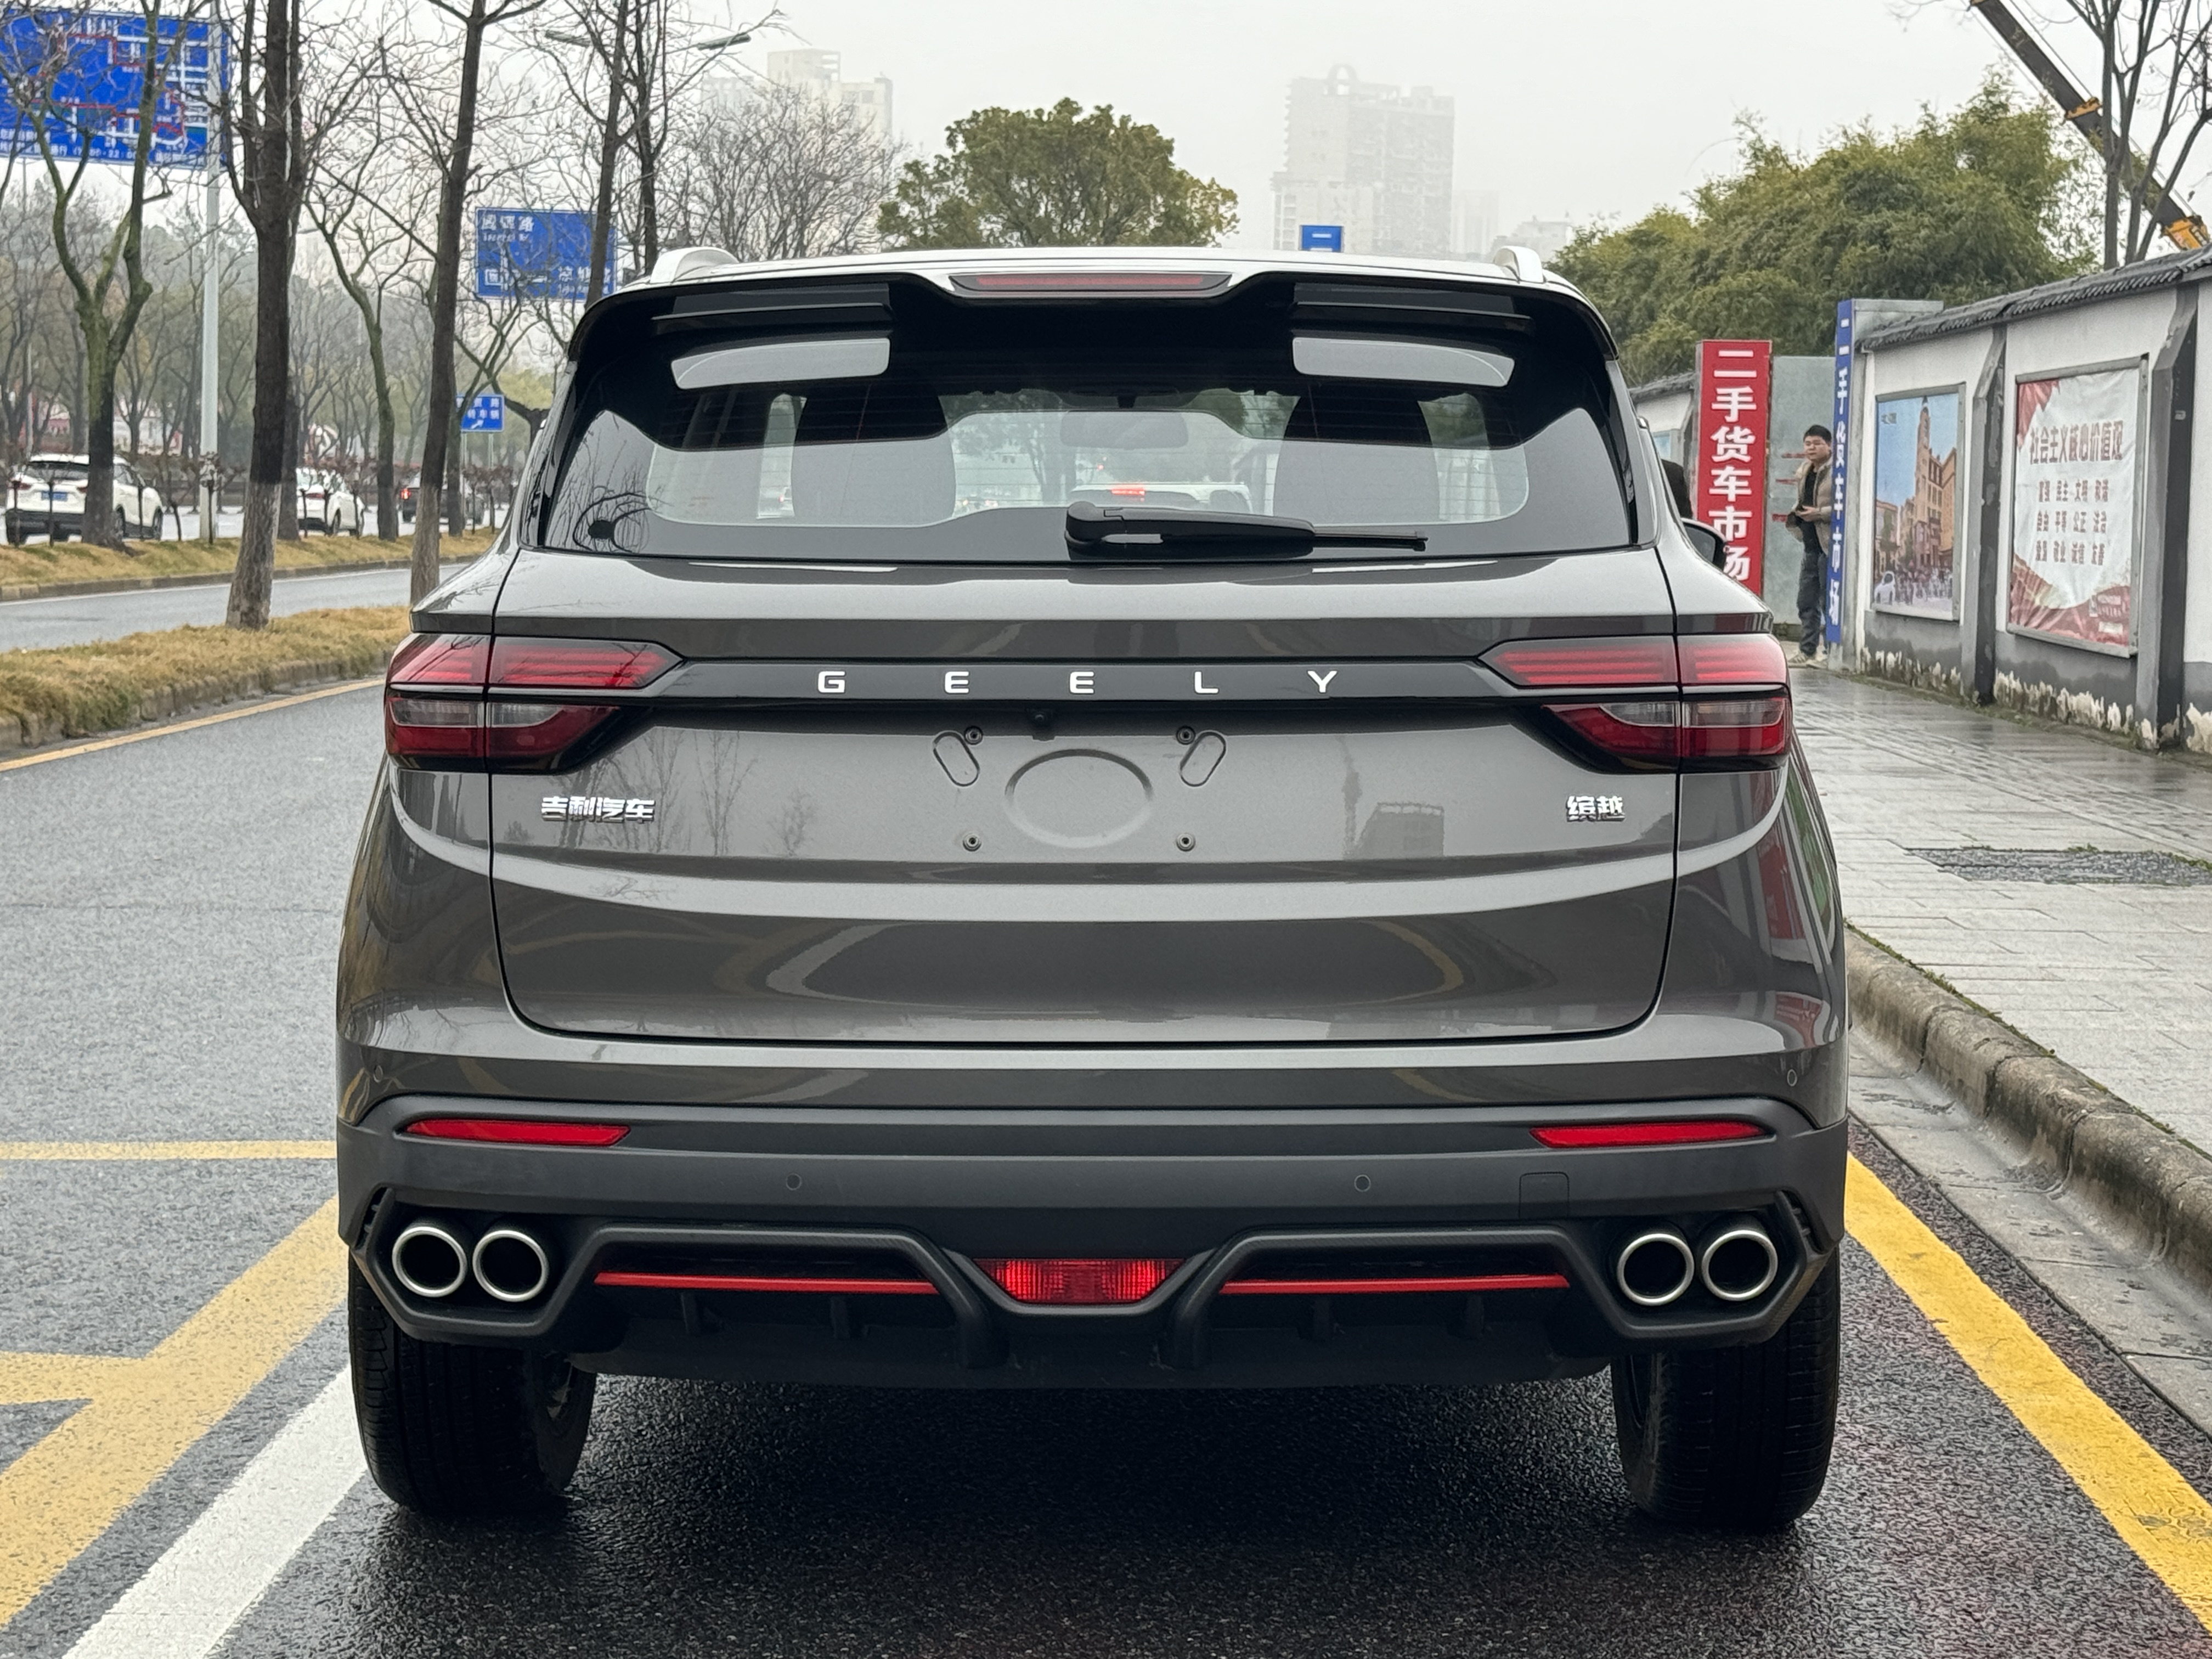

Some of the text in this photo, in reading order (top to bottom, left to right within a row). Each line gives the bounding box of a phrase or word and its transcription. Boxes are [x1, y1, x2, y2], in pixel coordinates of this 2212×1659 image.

[2030, 420, 2124, 465] 社会主义核心价值观
[1829, 318, 1850, 627] 二手货车市场
[817, 670, 1338, 695] GEELY
[541, 795, 656, 823] 吉利汽车
[1566, 795, 1626, 821] 缤越
